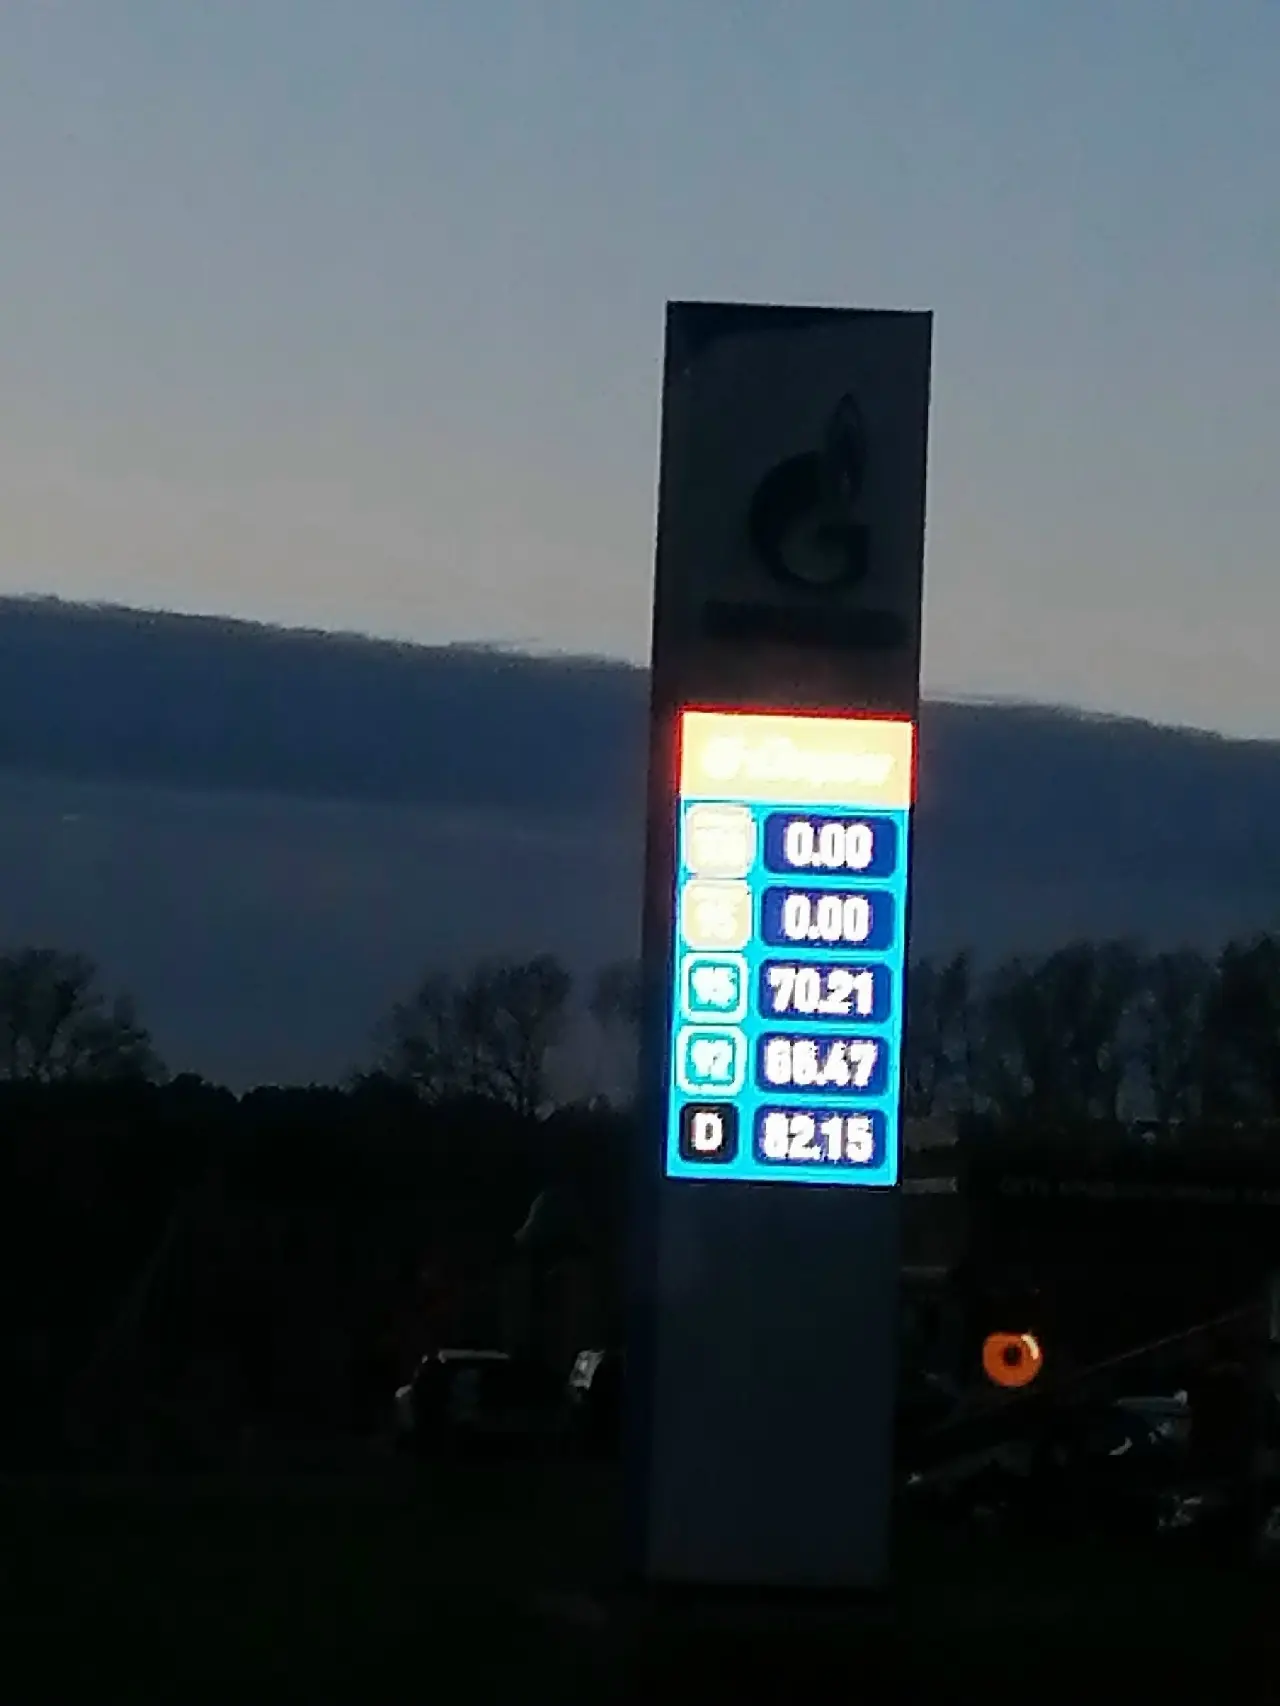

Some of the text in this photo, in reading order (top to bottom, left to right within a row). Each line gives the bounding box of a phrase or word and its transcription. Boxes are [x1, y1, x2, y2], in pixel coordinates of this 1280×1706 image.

[785, 821, 873, 869] 0.00
[783, 893, 870, 942] 0.00
[769, 967, 874, 1015] 70.21
[692, 1111, 723, 1152] D
[762, 1111, 874, 1163] 82.15
